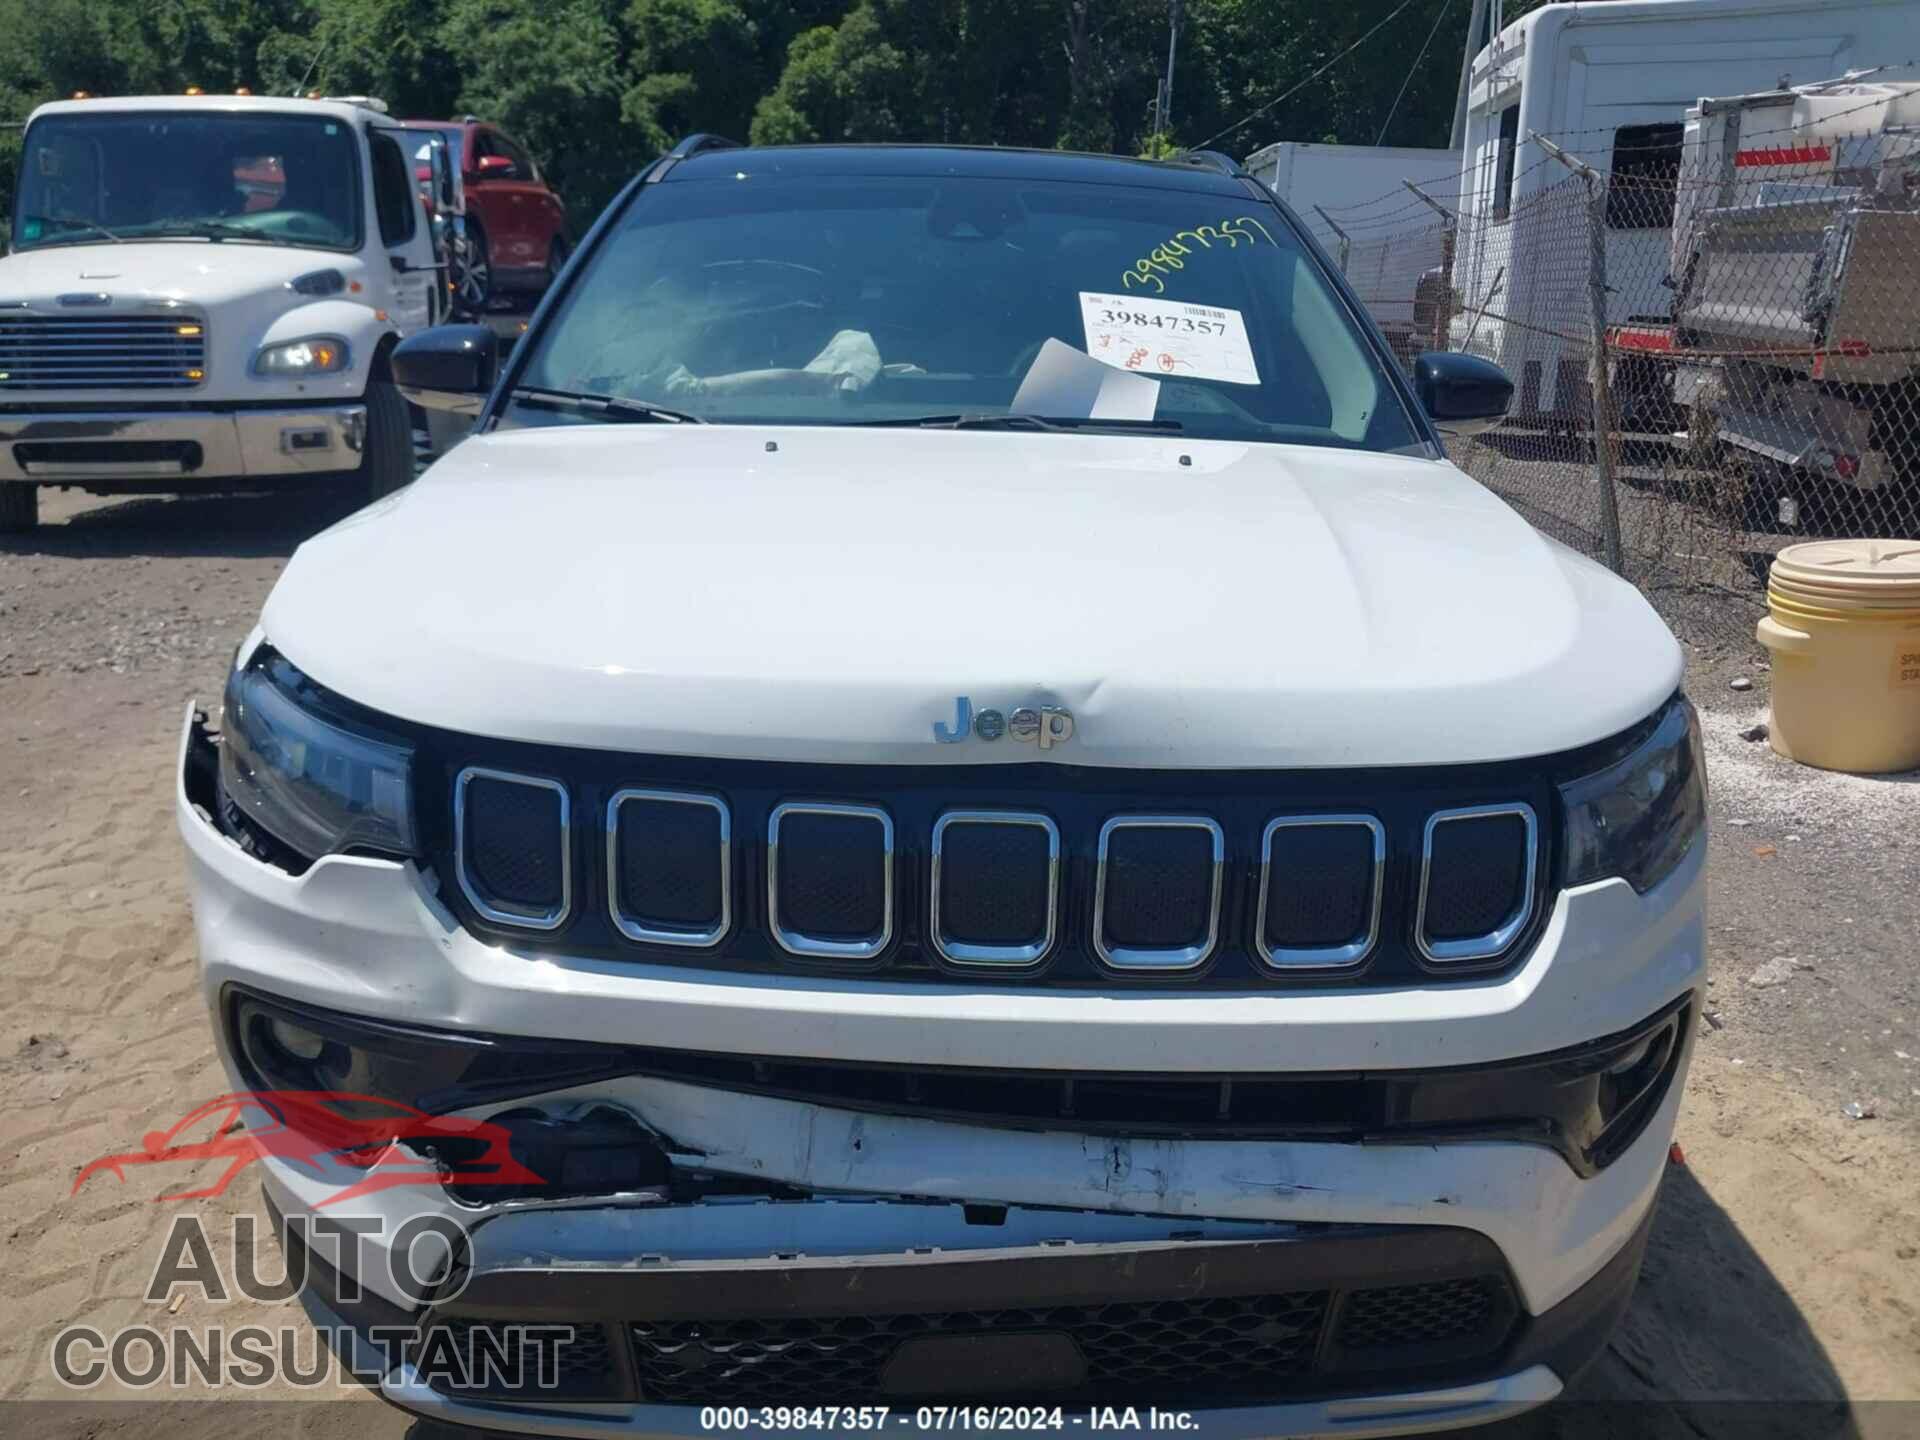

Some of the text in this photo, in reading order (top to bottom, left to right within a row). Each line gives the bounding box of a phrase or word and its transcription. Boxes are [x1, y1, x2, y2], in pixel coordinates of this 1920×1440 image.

[1123, 217, 1278, 293] 39847357
[1101, 309, 1226, 337] 39847357
[933, 695, 1074, 750] Jeep
